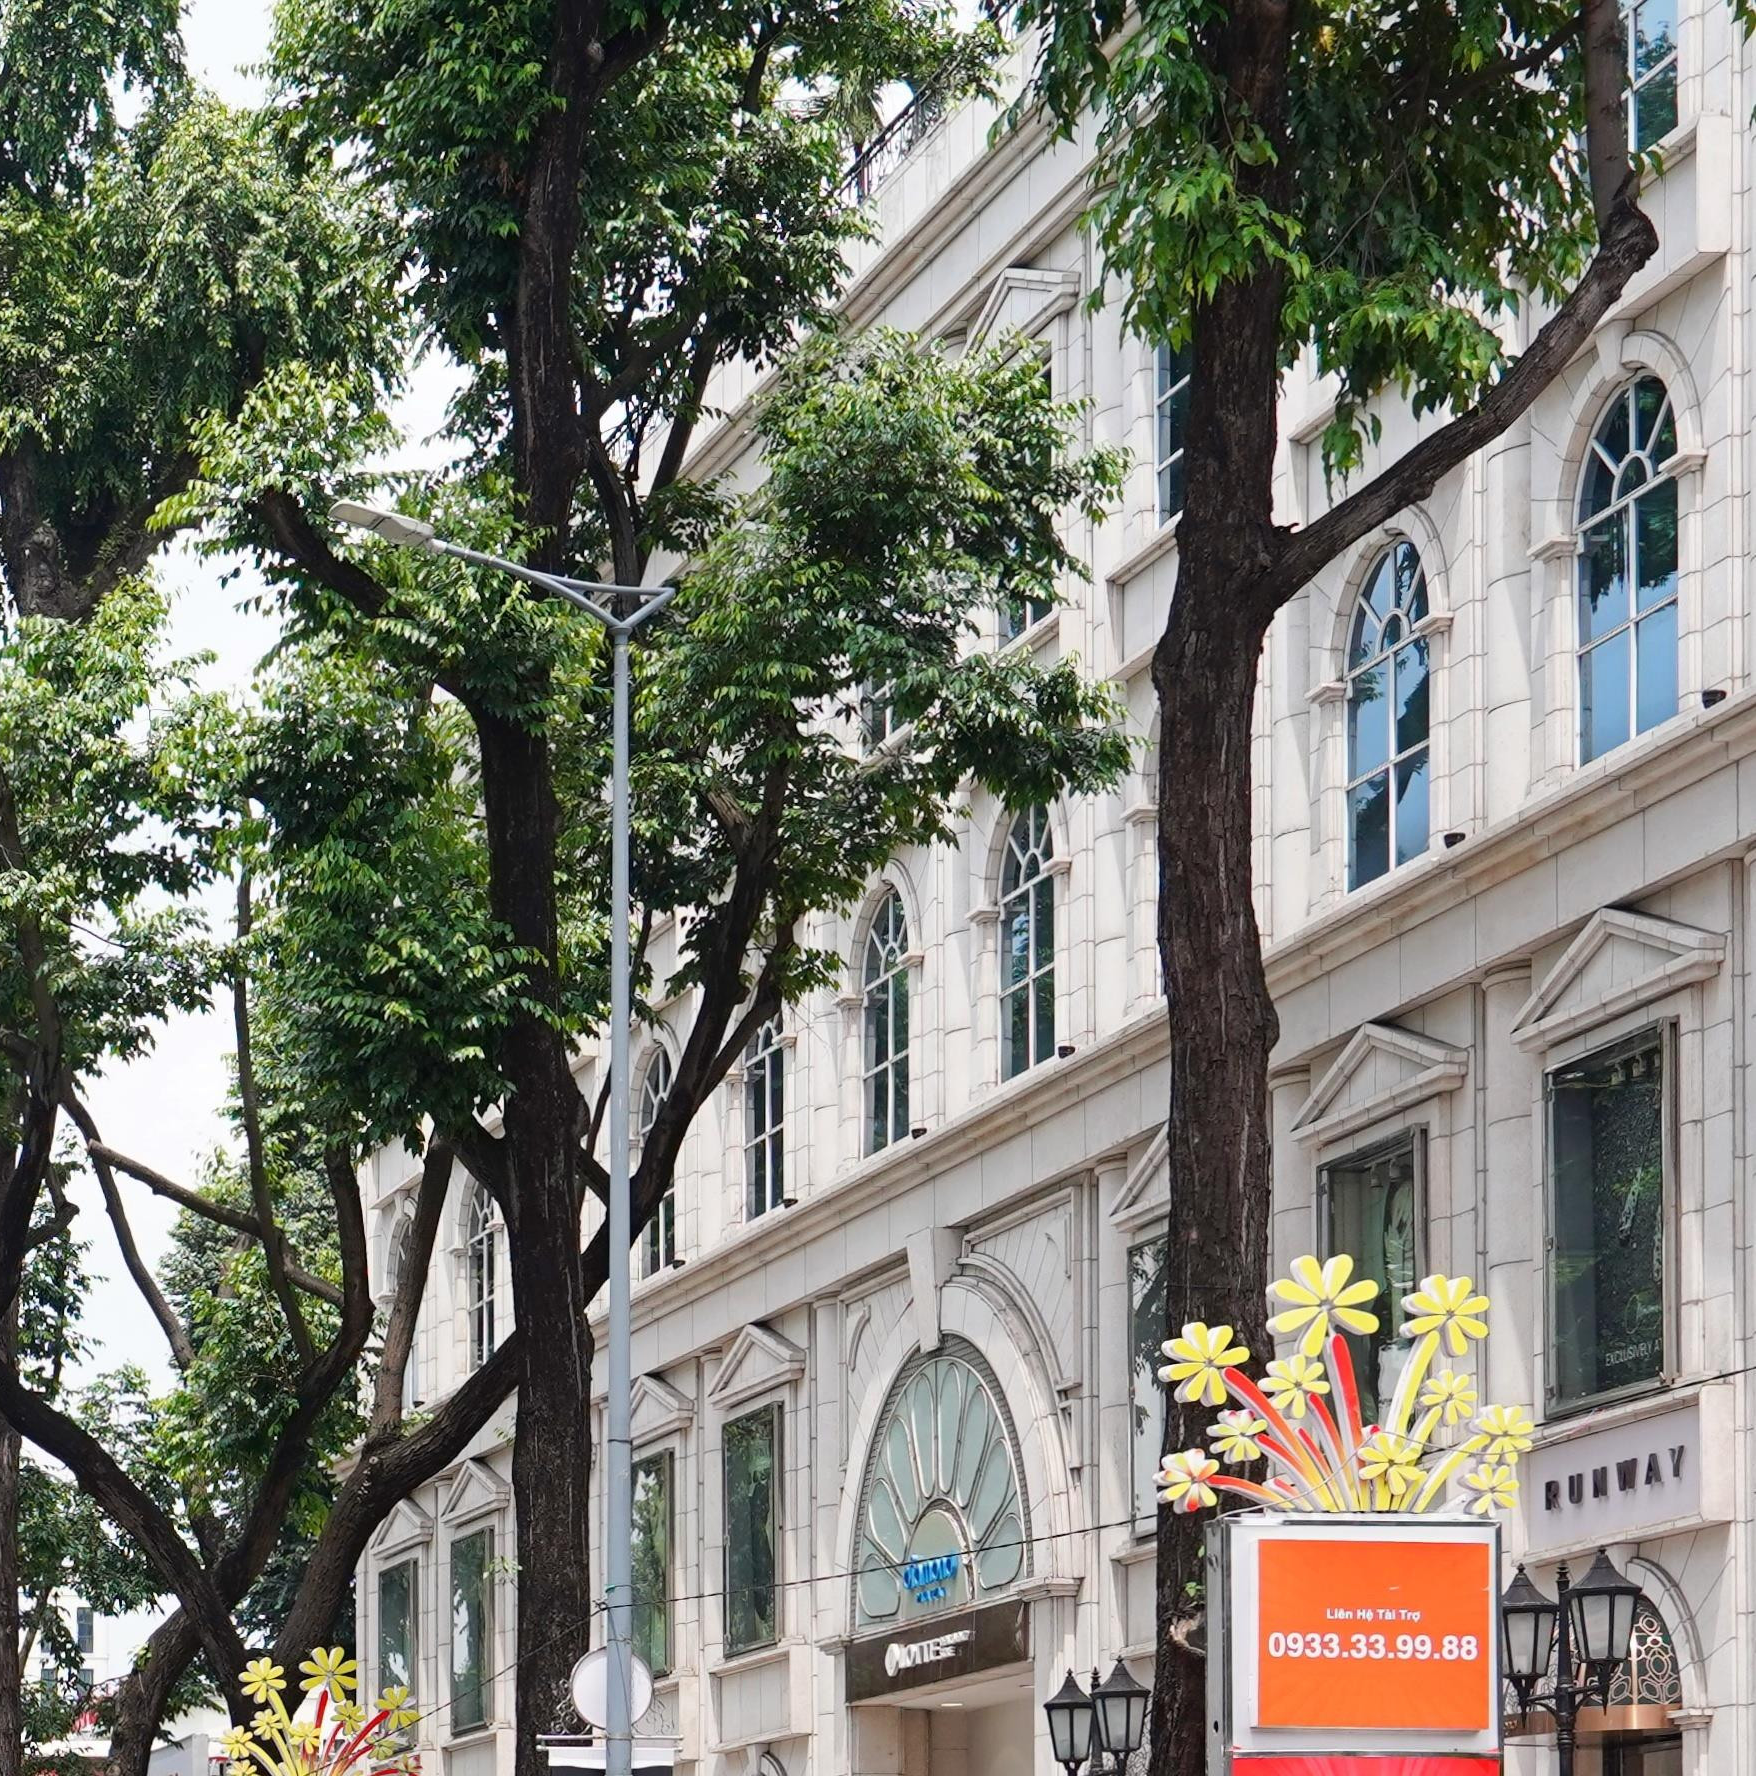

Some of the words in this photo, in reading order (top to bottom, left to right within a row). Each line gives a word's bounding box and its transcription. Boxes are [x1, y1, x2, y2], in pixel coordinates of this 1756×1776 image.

[1544, 1444, 1685, 1511] RUNWAY
[1326, 1609, 1354, 1620] Liên
[1357, 1609, 1373, 1622] Hệ
[1377, 1609, 1396, 1620] Tài
[1399, 1608, 1421, 1622] Trợ
[1268, 1632, 1478, 1661] 0933.33.99.88
